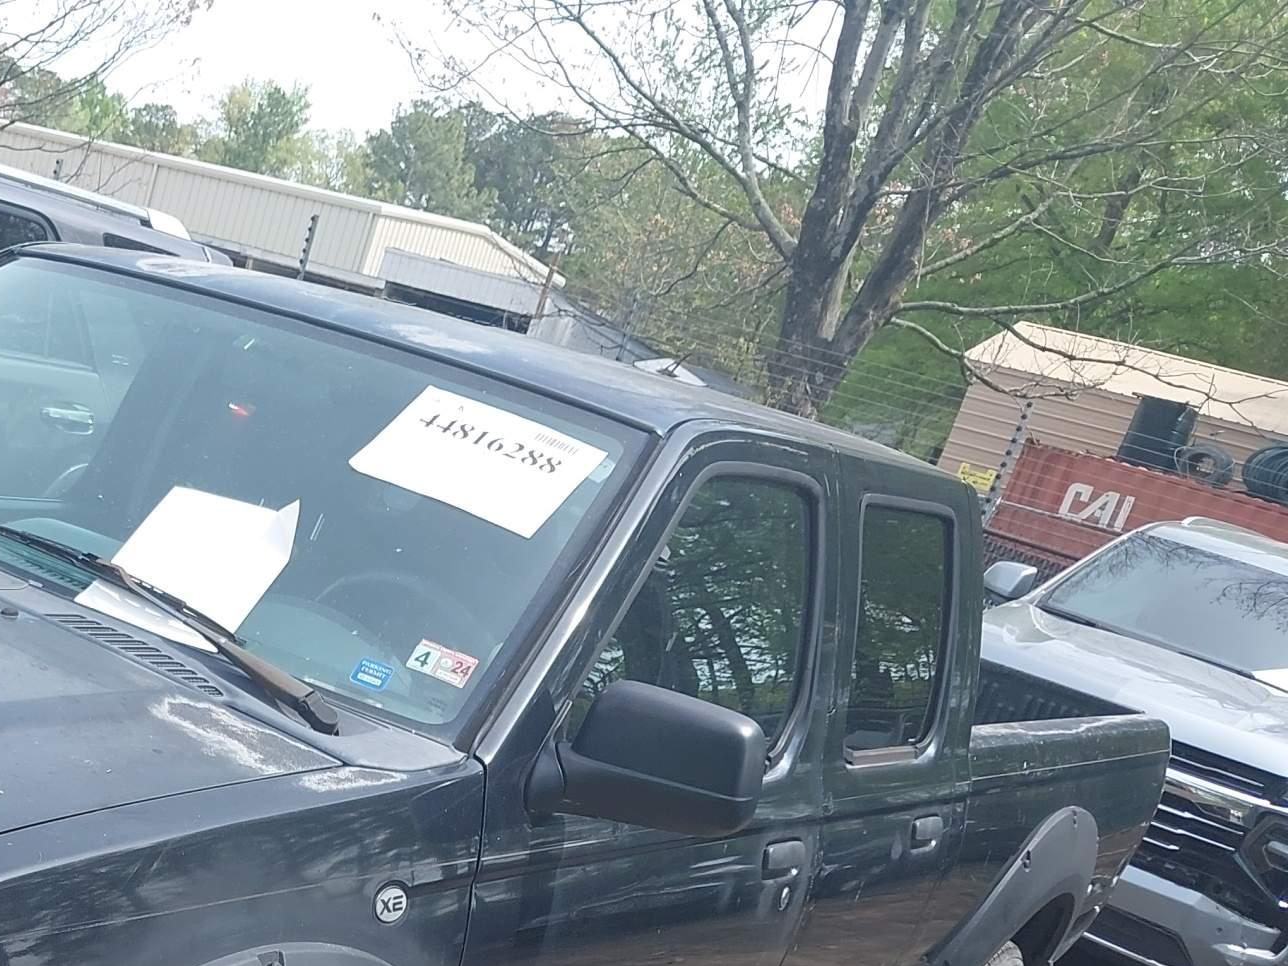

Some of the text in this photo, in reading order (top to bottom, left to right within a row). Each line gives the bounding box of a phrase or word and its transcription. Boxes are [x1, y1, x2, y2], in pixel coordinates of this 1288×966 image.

[419, 413, 562, 475] 44816288
[1058, 482, 1136, 532] CAI
[414, 651, 431, 668] 4
[450, 660, 472, 678] 24
[379, 894, 404, 916] XE
